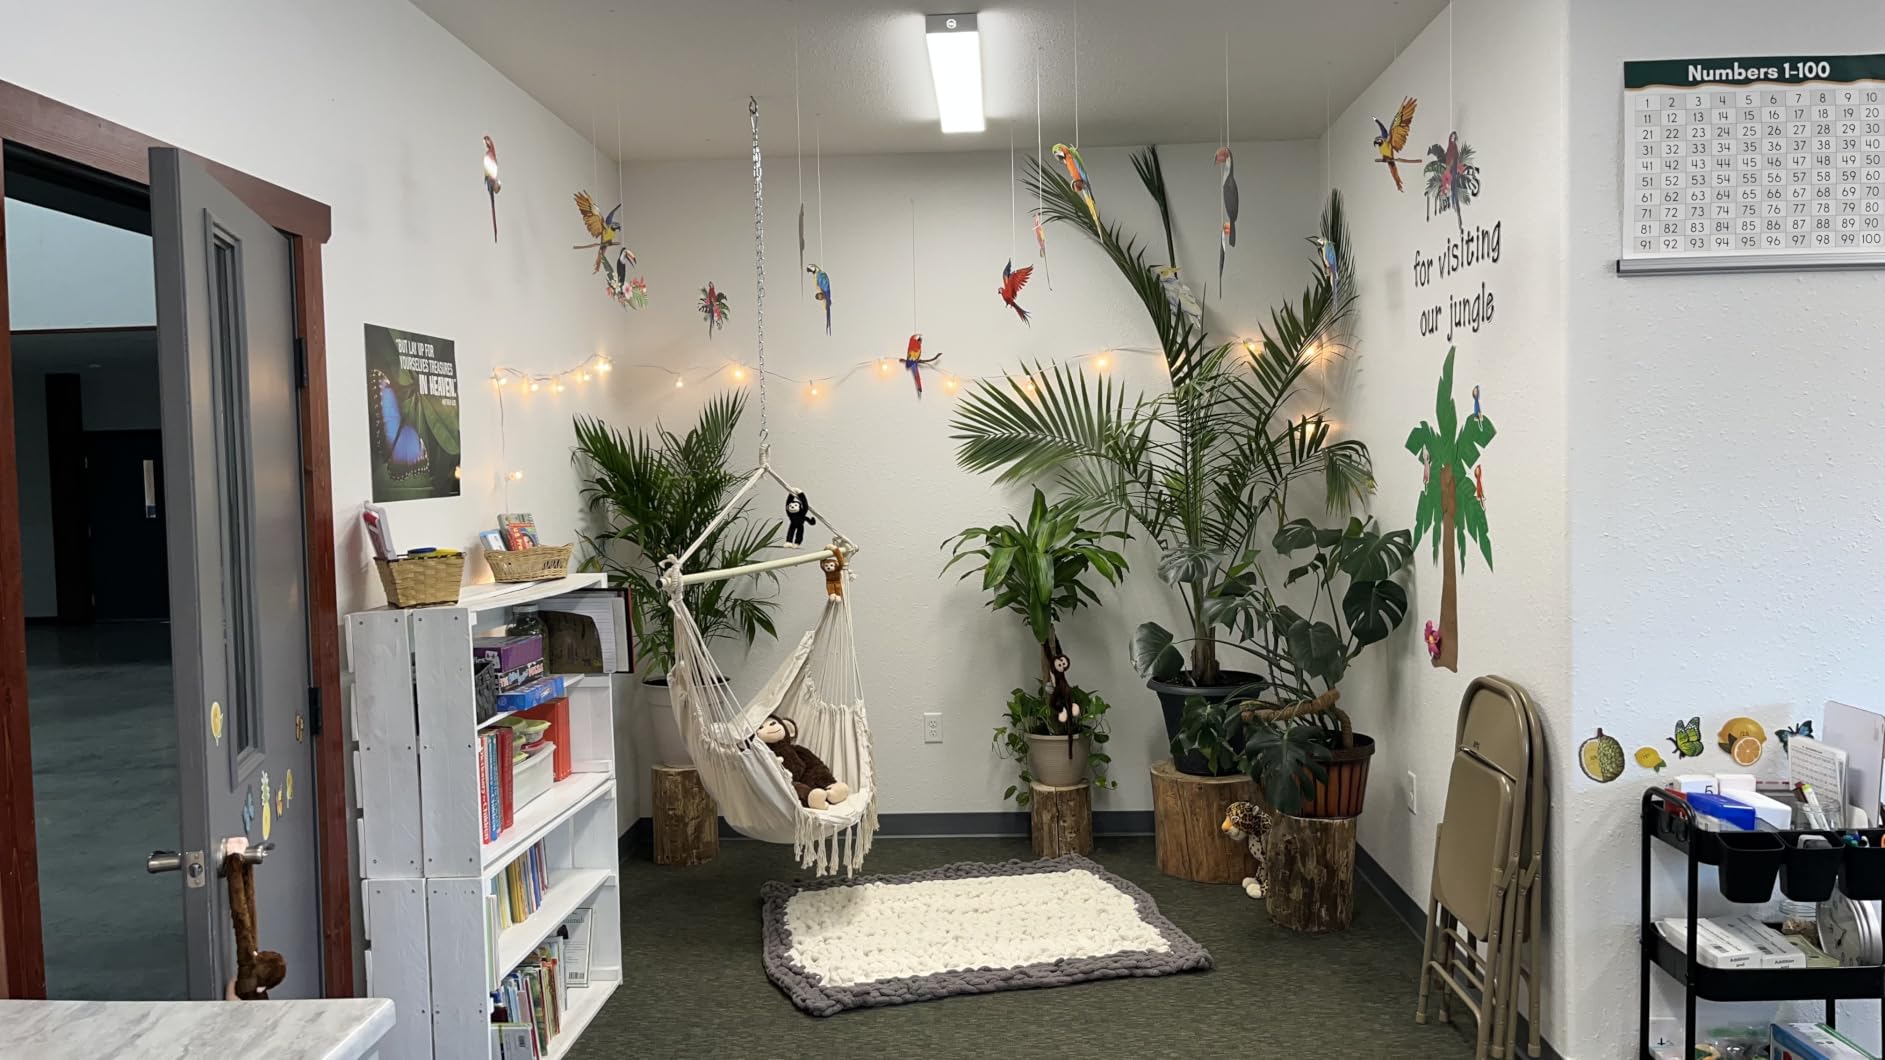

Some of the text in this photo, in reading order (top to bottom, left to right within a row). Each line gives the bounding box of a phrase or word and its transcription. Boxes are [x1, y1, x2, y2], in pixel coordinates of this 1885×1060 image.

[1688, 61, 1830, 82] Numbers 1-100
[1866, 92, 1877, 102] 10
[1644, 107, 1879, 123] 11 12 13 14 15 16 17 18 19 20
[1642, 122, 1880, 139] 21 22 23 24 25 26 27 28 29 30
[1642, 138, 1880, 155] 31 32 33 34 35 36 37 38 39 40
[1642, 154, 1880, 170] 41 42 43 44 45 46 47 48 49 50
[1642, 170, 1880, 187] 51 52 53 54 55 56 57 58 59 60
[1641, 186, 1879, 202] 61 62 63 64 65 66 67 68 69 70
[1641, 201, 1879, 218] 71 72 73 74 75 76 77 78 79 80
[1640, 217, 1878, 234] 81 82 83 84 85 86 87 88 89 90
[1640, 233, 1880, 249] 91 92 93 94 95 96 97 98 99 100
[1414, 220, 1501, 287] for visiting
[1420, 282, 1494, 342] our jungle
[408, 341, 417, 355] LAY
[417, 343, 424, 356] UP
[425, 344, 434, 358] FOR
[399, 355, 453, 376] YOURSELVES TREASURES
[419, 374, 428, 394] IN
